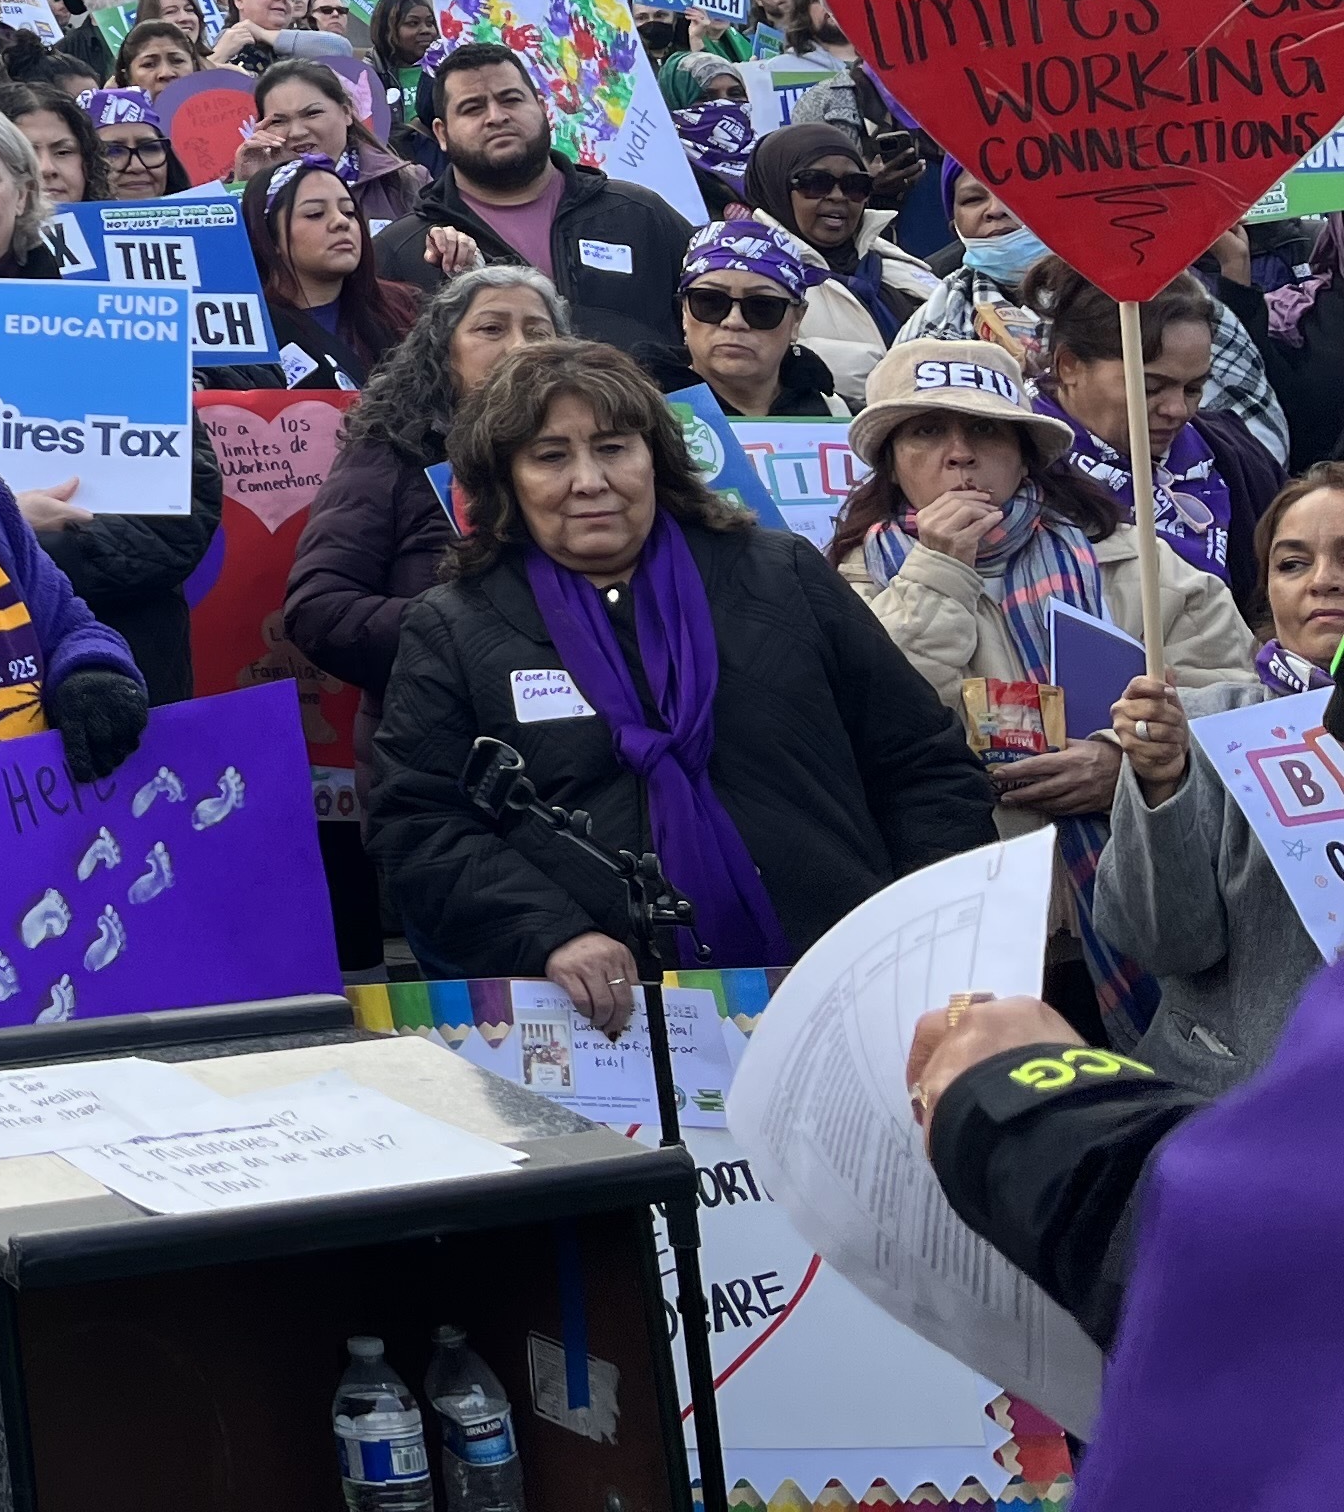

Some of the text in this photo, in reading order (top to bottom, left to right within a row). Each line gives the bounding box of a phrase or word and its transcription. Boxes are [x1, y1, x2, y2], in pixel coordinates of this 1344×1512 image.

[963, 31, 1326, 127] WORKING
[618, 106, 659, 169] wait
[106, 216, 235, 229] NOT JUST THE RICH
[182, 206, 208, 218] FOR
[114, 241, 187, 281] THE
[98, 294, 179, 317] FUND
[4, 313, 179, 342] EDUCATION
[915, 360, 1022, 407] SEIU
[90, 421, 181, 459] Tax
[203, 416, 311, 437] No a los
[221, 434, 309, 458] limites de
[220, 459, 293, 478] Working
[237, 471, 324, 493] Connections
[1214, 526, 1228, 569] SEIU
[7, 654, 39, 681] 925
[1005, 736, 1034, 749] Mini
[594, 1055, 625, 1074] kids!
[1009, 1048, 1155, 1091] CG
[30, 1087, 102, 1109] wealthy
[142, 1134, 281, 1162] millionaires
[239, 1140, 368, 1170] do we want
